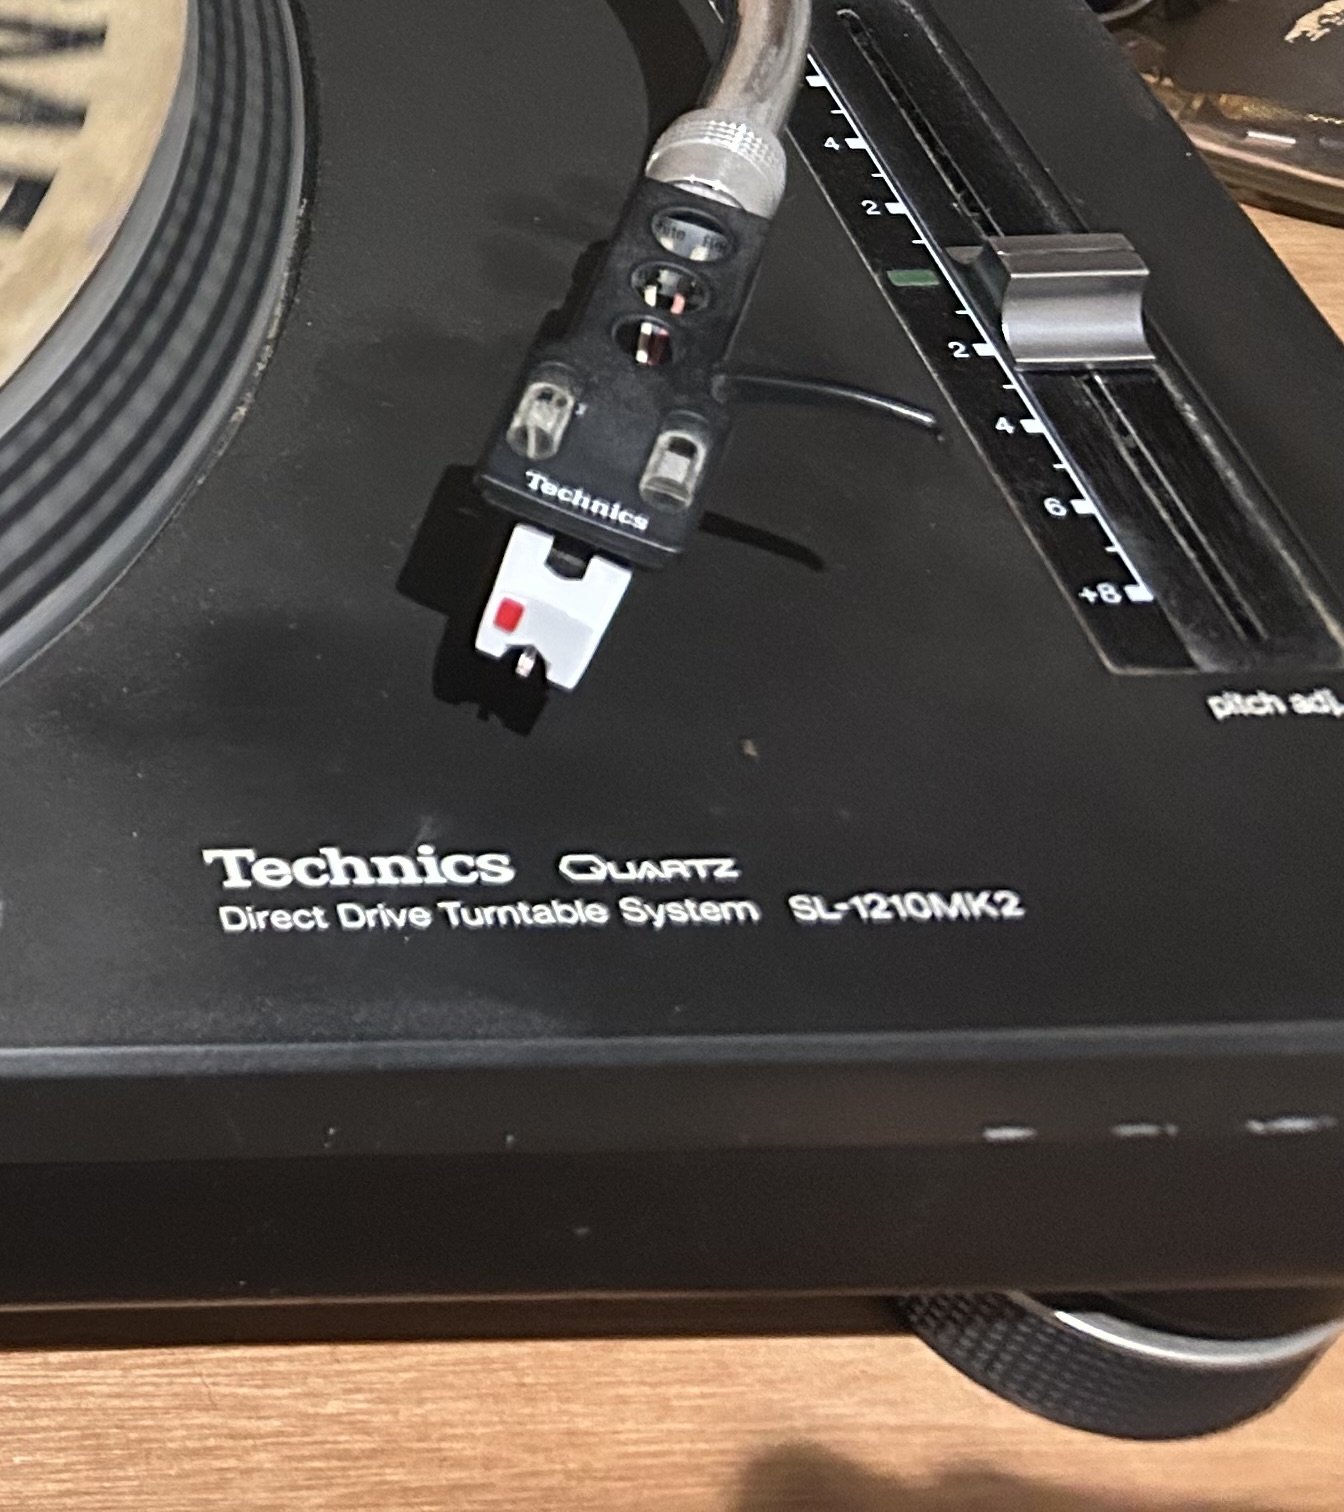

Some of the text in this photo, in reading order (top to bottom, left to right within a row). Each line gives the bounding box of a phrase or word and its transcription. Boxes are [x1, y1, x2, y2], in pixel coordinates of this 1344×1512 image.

[823, 136, 840, 151] 4
[861, 200, 881, 216] 2
[948, 341, 970, 359] 2
[994, 417, 1015, 433] 4
[525, 470, 649, 530] Technics
[1043, 498, 1067, 517] 6
[1078, 582, 1122, 603] +8
[1207, 690, 1287, 720] pitch
[202, 844, 515, 888] Technics
[219, 889, 1026, 931] Direct Drive Turntable System SL-1210MK2
